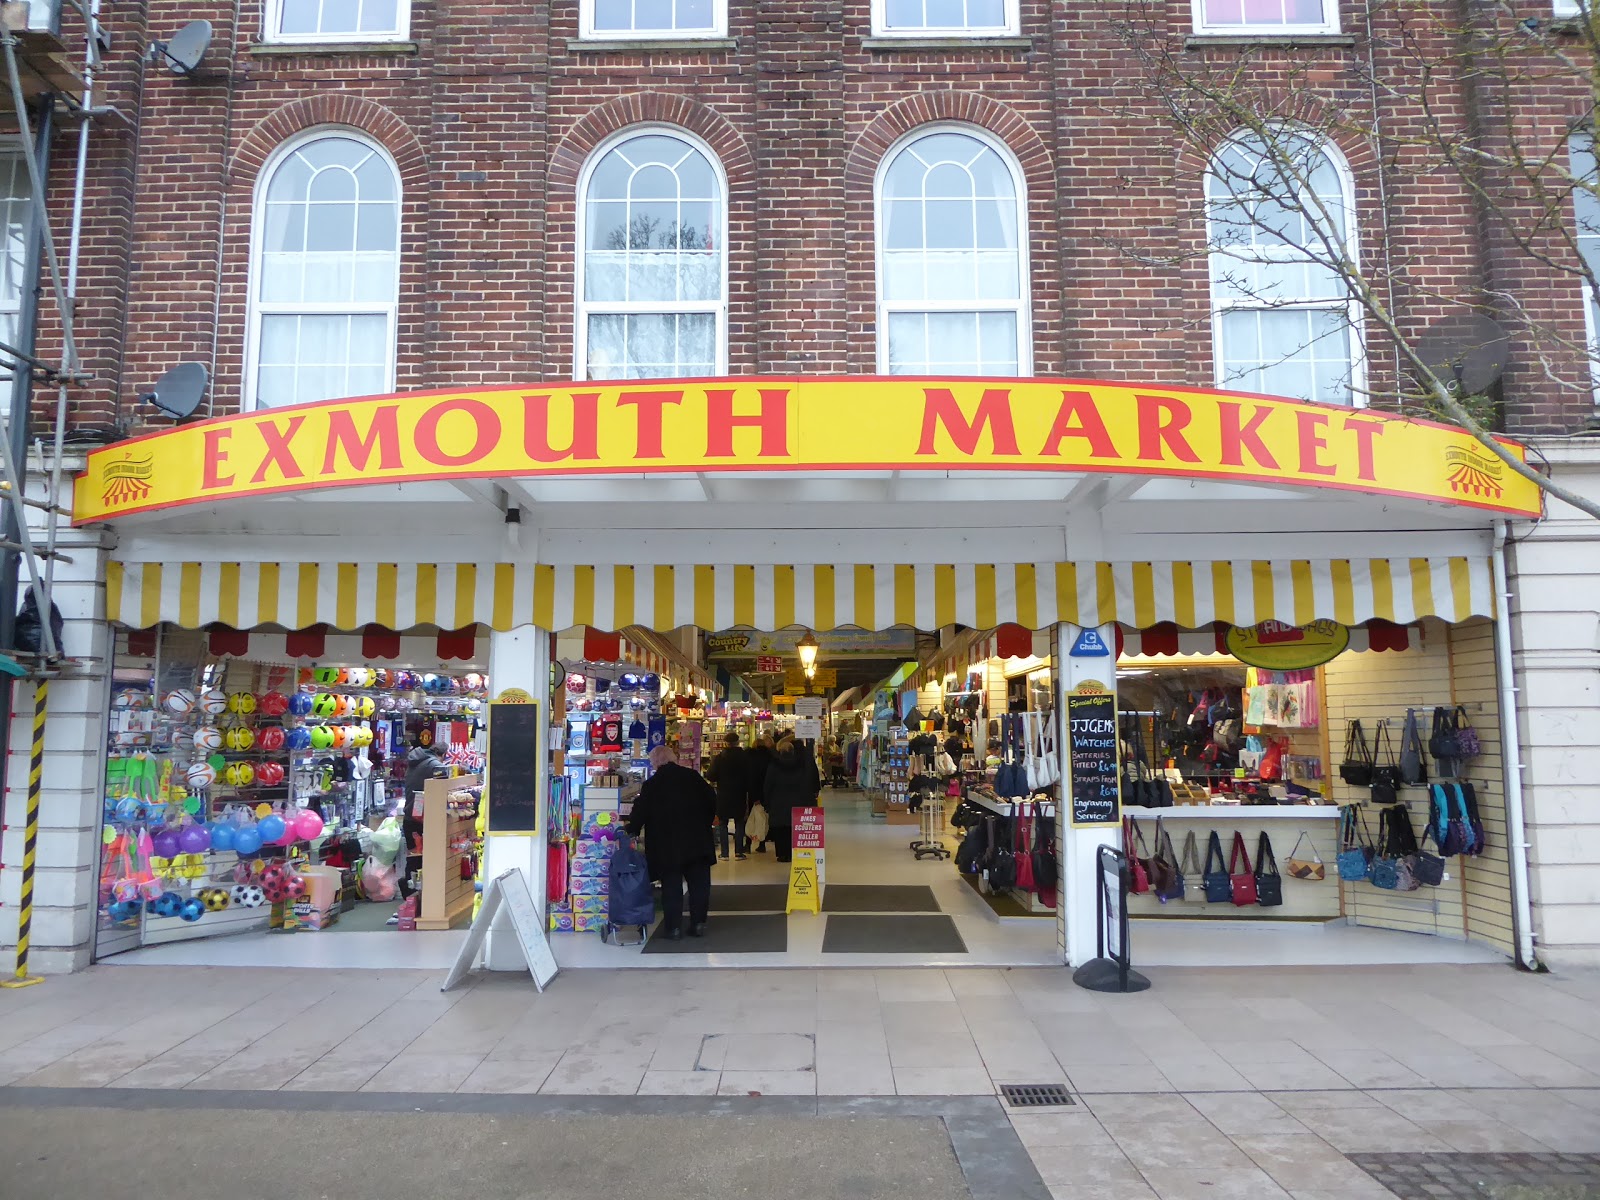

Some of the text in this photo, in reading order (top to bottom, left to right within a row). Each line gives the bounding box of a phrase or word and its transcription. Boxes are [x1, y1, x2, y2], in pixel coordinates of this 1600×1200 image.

[202, 388, 1382, 490] EXMOUTH MARKET
[708, 637, 748, 646] Country
[1080, 643, 1103, 651] Chubb
[1070, 697, 1112, 708] Special Offers
[1073, 735, 1116, 748] WATCHES
[1073, 774, 1100, 783] STRAPS
[1073, 796, 1113, 815] Engraving
[1076, 810, 1107, 821] Service
